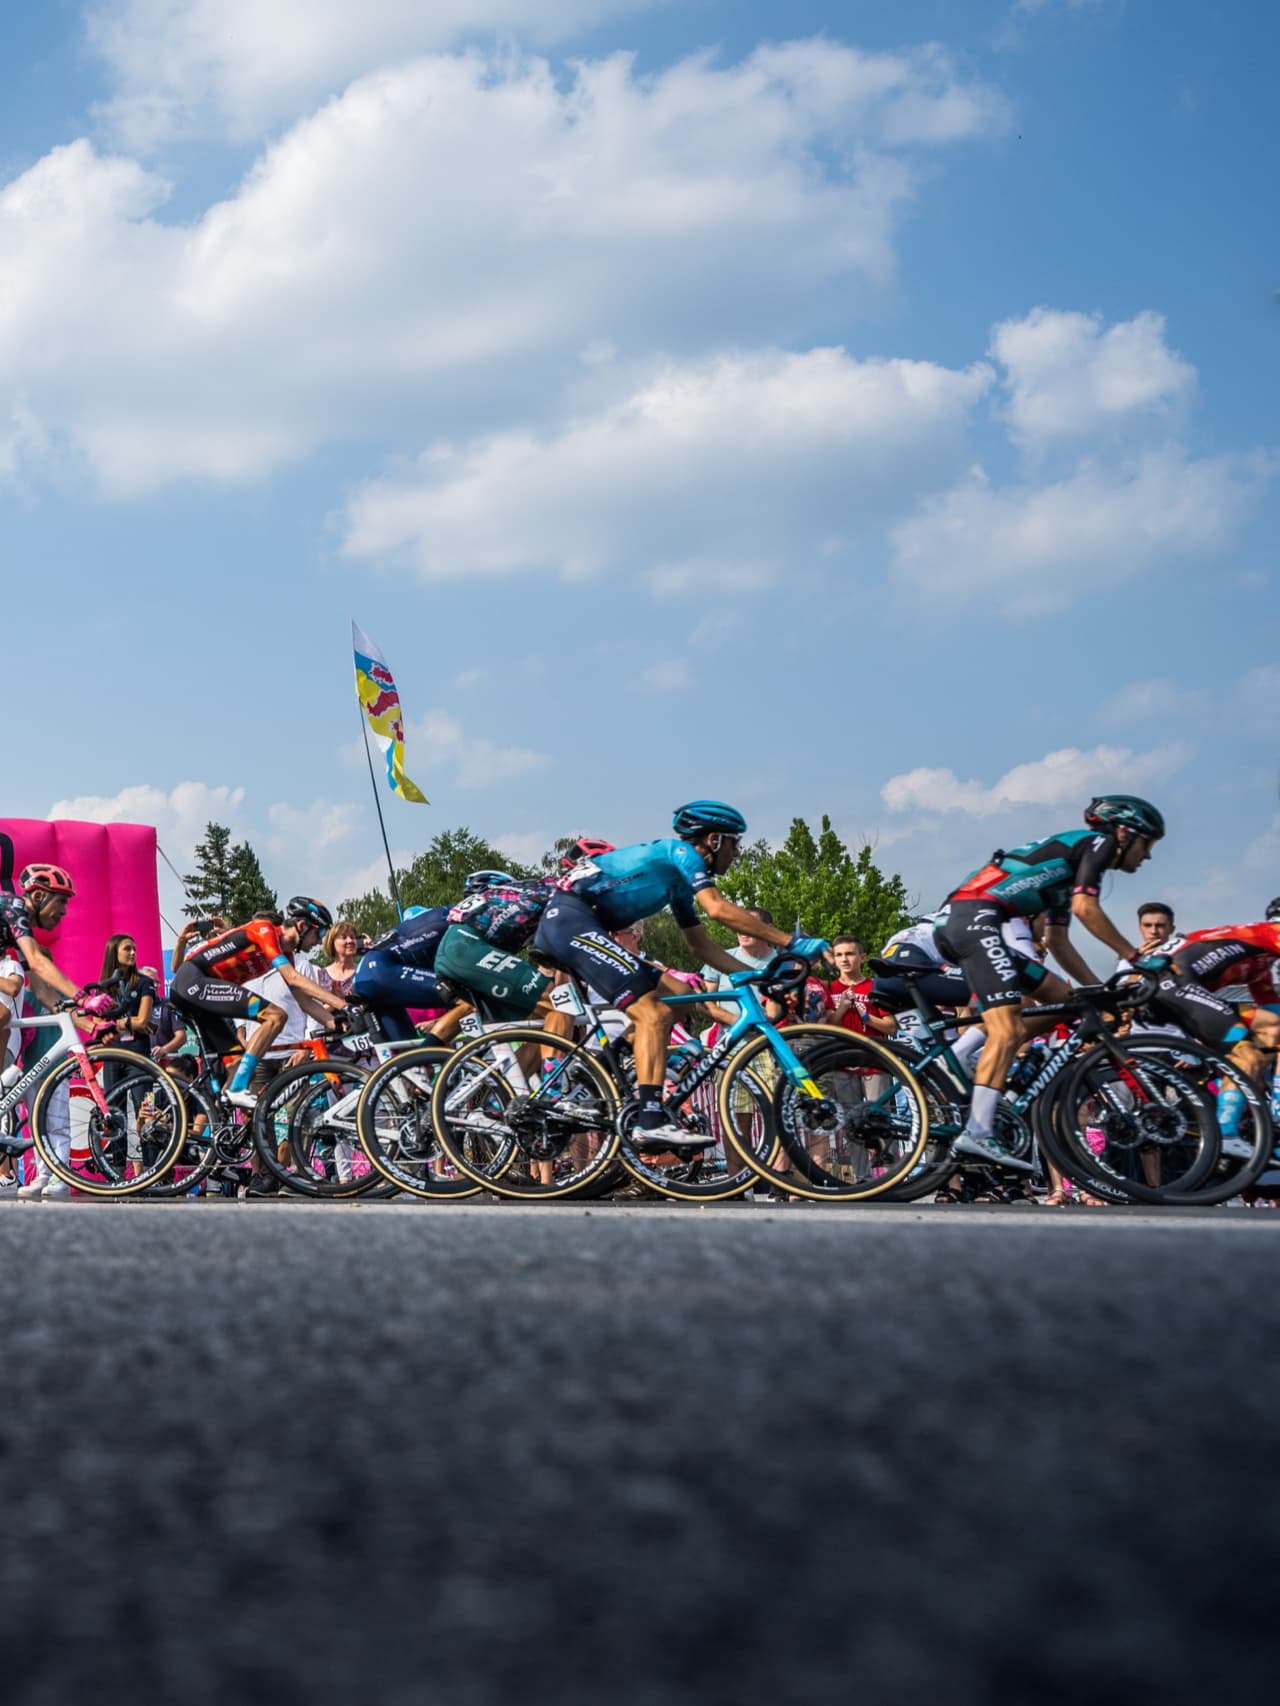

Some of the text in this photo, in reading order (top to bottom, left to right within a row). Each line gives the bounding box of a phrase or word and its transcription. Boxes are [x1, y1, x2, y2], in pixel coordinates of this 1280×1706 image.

[998, 866, 1066, 899] hansgrohe
[203, 942, 237, 961] BAHRAIN
[980, 935, 1017, 983] BORA
[198, 983, 243, 1002] friendly
[551, 991, 572, 1008] 31
[986, 992, 1004, 1002] LE
[460, 1017, 479, 1032] 95
[1015, 1034, 1084, 1113] S-WORKS
